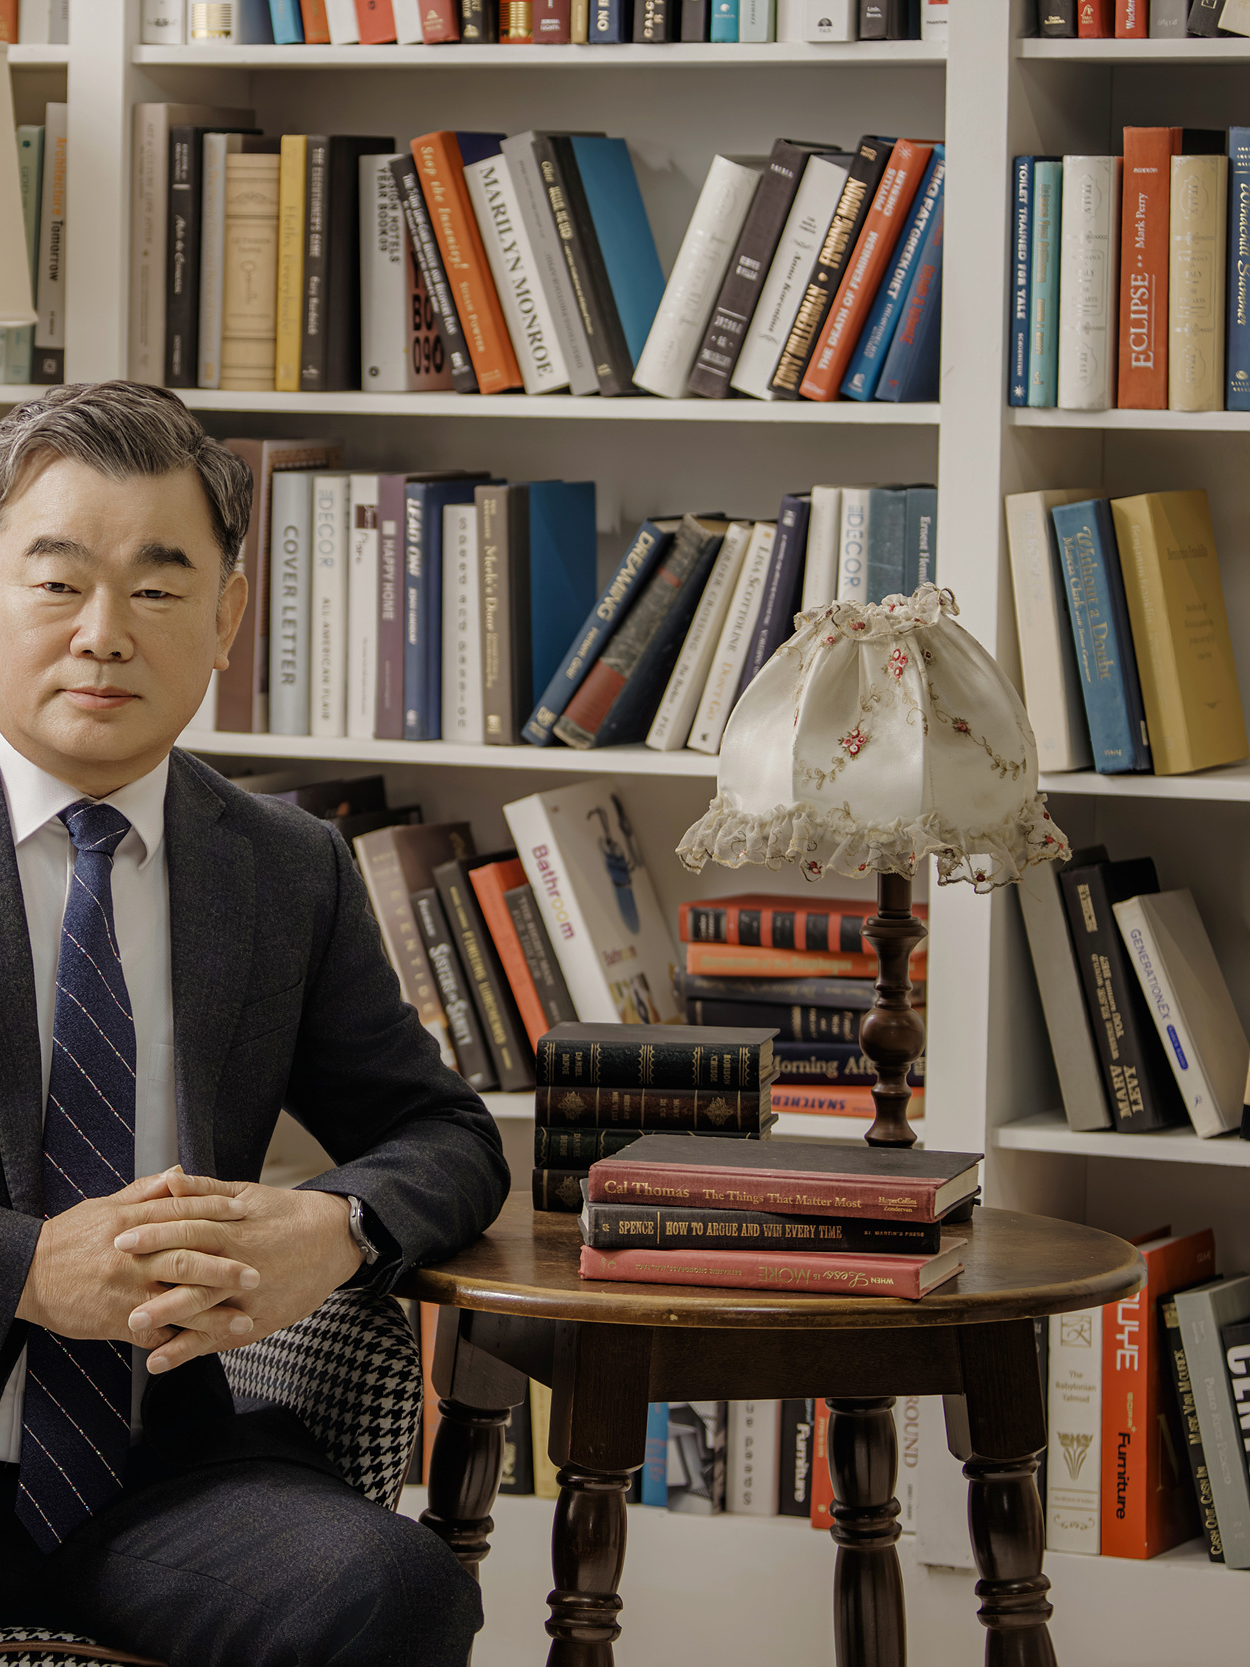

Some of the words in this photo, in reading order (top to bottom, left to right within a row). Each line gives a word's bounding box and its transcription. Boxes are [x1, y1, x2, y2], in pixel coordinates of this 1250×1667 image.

[50, 136, 68, 216] Architecture
[417, 143, 440, 177] Stop
[375, 166, 388, 198] YEAR
[429, 178, 448, 202] the
[834, 175, 870, 221] MOON
[872, 165, 898, 212] PHYLLIS
[881, 168, 908, 217] CHESLER
[923, 163, 947, 199] BIG
[1017, 163, 1029, 204] TOILET
[910, 195, 935, 232] FAT
[1135, 191, 1148, 218] Perry
[47, 219, 63, 282] Tomorrow
[387, 215, 400, 263] HOTELS
[435, 204, 470, 273] Insanity!
[816, 213, 857, 270] FINDING
[894, 226, 923, 272] GREEK
[1016, 206, 1029, 261] TRAINED
[1133, 218, 1147, 248] Mark
[478, 165, 525, 273] MARILYN
[510, 276, 555, 378] MONROE
[847, 229, 880, 290] FEMINISM
[1016, 262, 1027, 286] FOR
[840, 288, 857, 308] OF
[884, 267, 907, 300] DIET
[1234, 259, 1250, 325] Summer
[765, 281, 793, 334] Karenina
[783, 282, 832, 358] HILLERMAN
[1015, 288, 1027, 320] YALE
[1124, 270, 1160, 370] ECLIPSE
[826, 305, 851, 347] DEATH
[770, 350, 807, 393] TONY
[816, 345, 835, 371] THE
[317, 496, 334, 568] DECOR
[405, 497, 421, 543] LEAD
[918, 515, 931, 550] Ernest
[281, 524, 299, 598] COVER
[381, 538, 396, 581] HAPPY
[711, 536, 739, 588] BORDER
[750, 545, 769, 574] LISA
[843, 512, 864, 587] DECOR
[1060, 535, 1080, 576] Marcia
[1074, 524, 1104, 604] Without
[594, 527, 656, 625] DREAMING
[1067, 576, 1085, 609] Clark
[381, 581, 395, 621] HOME
[686, 589, 719, 653] CROSSING
[725, 573, 762, 654] SCOTTOLINE
[1088, 607, 1100, 619] a
[279, 605, 297, 685] LETTER
[1089, 620, 1118, 681] Doubt
[711, 661, 734, 700] DON'T
[704, 698, 722, 722] GO
[528, 842, 581, 941] Bathroom
[1110, 1011, 1125, 1039] YOU
[561, 1053, 569, 1074] DEFOE
[574, 1051, 582, 1076] DANIEL
[709, 1055, 718, 1082] CRUSOE
[771, 1055, 838, 1077] Morning
[771, 1095, 846, 1111] SNATCHED
[1108, 1062, 1132, 1120] MARV
[1122, 1063, 1144, 1114] LEVY
[559, 1134, 567, 1156] DEFOE
[603, 1179, 628, 1195] Cal
[630, 1181, 690, 1200] Thomas
[701, 1188, 725, 1201] The
[725, 1189, 765, 1205] Things
[765, 1192, 794, 1206] That
[794, 1194, 833, 1208] Matter
[833, 1196, 862, 1209] Most
[618, 1219, 654, 1235] SPENCE
[665, 1221, 688, 1236] HOW
[690, 1221, 704, 1236] TO
[705, 1221, 739, 1237] ARGUE
[741, 1222, 760, 1237] AND
[762, 1223, 783, 1237] WIN
[784, 1223, 816, 1239] EVERY
[818, 1224, 842, 1239] TIME
[756, 1264, 810, 1284] MORE
[812, 1272, 820, 1280] IS
[821, 1267, 870, 1289] Less
[869, 1275, 894, 1285] WHEN
[1055, 1381, 1097, 1393] Babylonian
[1069, 1370, 1083, 1380] The
[1203, 1375, 1220, 1411] PABLO
[1062, 1394, 1091, 1404] Talmud
[794, 1423, 811, 1503] Furniture
[1115, 1432, 1130, 1519] Furniture
